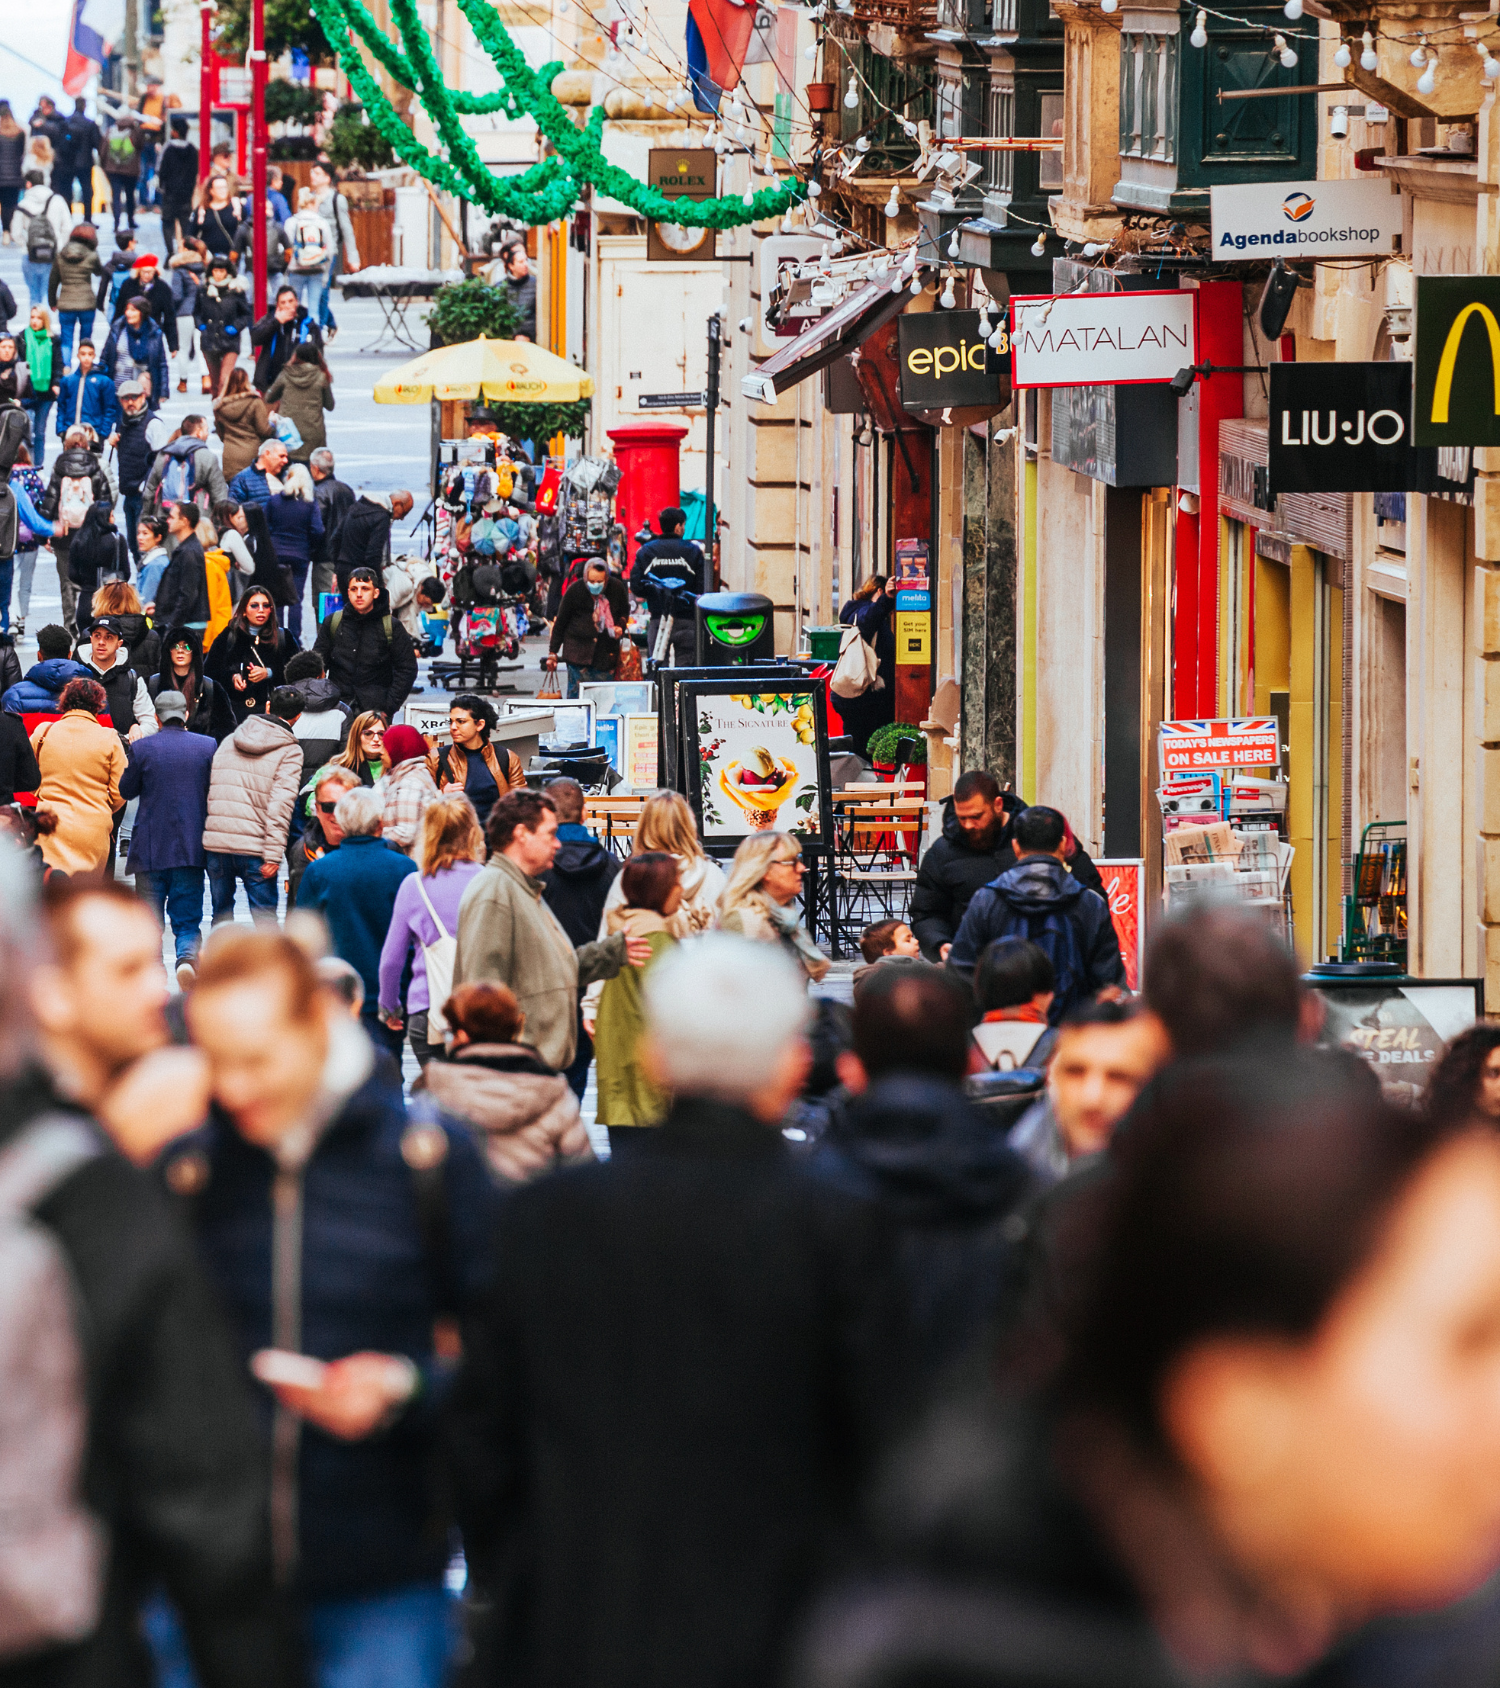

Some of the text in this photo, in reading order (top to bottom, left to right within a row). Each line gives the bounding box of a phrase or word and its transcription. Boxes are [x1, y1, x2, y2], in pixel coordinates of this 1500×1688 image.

[659, 176, 706, 186] ROLEX
[1220, 226, 1380, 250] Agendabookshop
[1023, 323, 1188, 354] MATALAN
[907, 339, 985, 379] epic
[902, 593, 927, 601] melita
[1163, 735, 1275, 750] TODAY'S NEWSPAPERS
[1168, 749, 1273, 765] ON SALE HERE
[1379, 1049, 1435, 1064] DEALS
